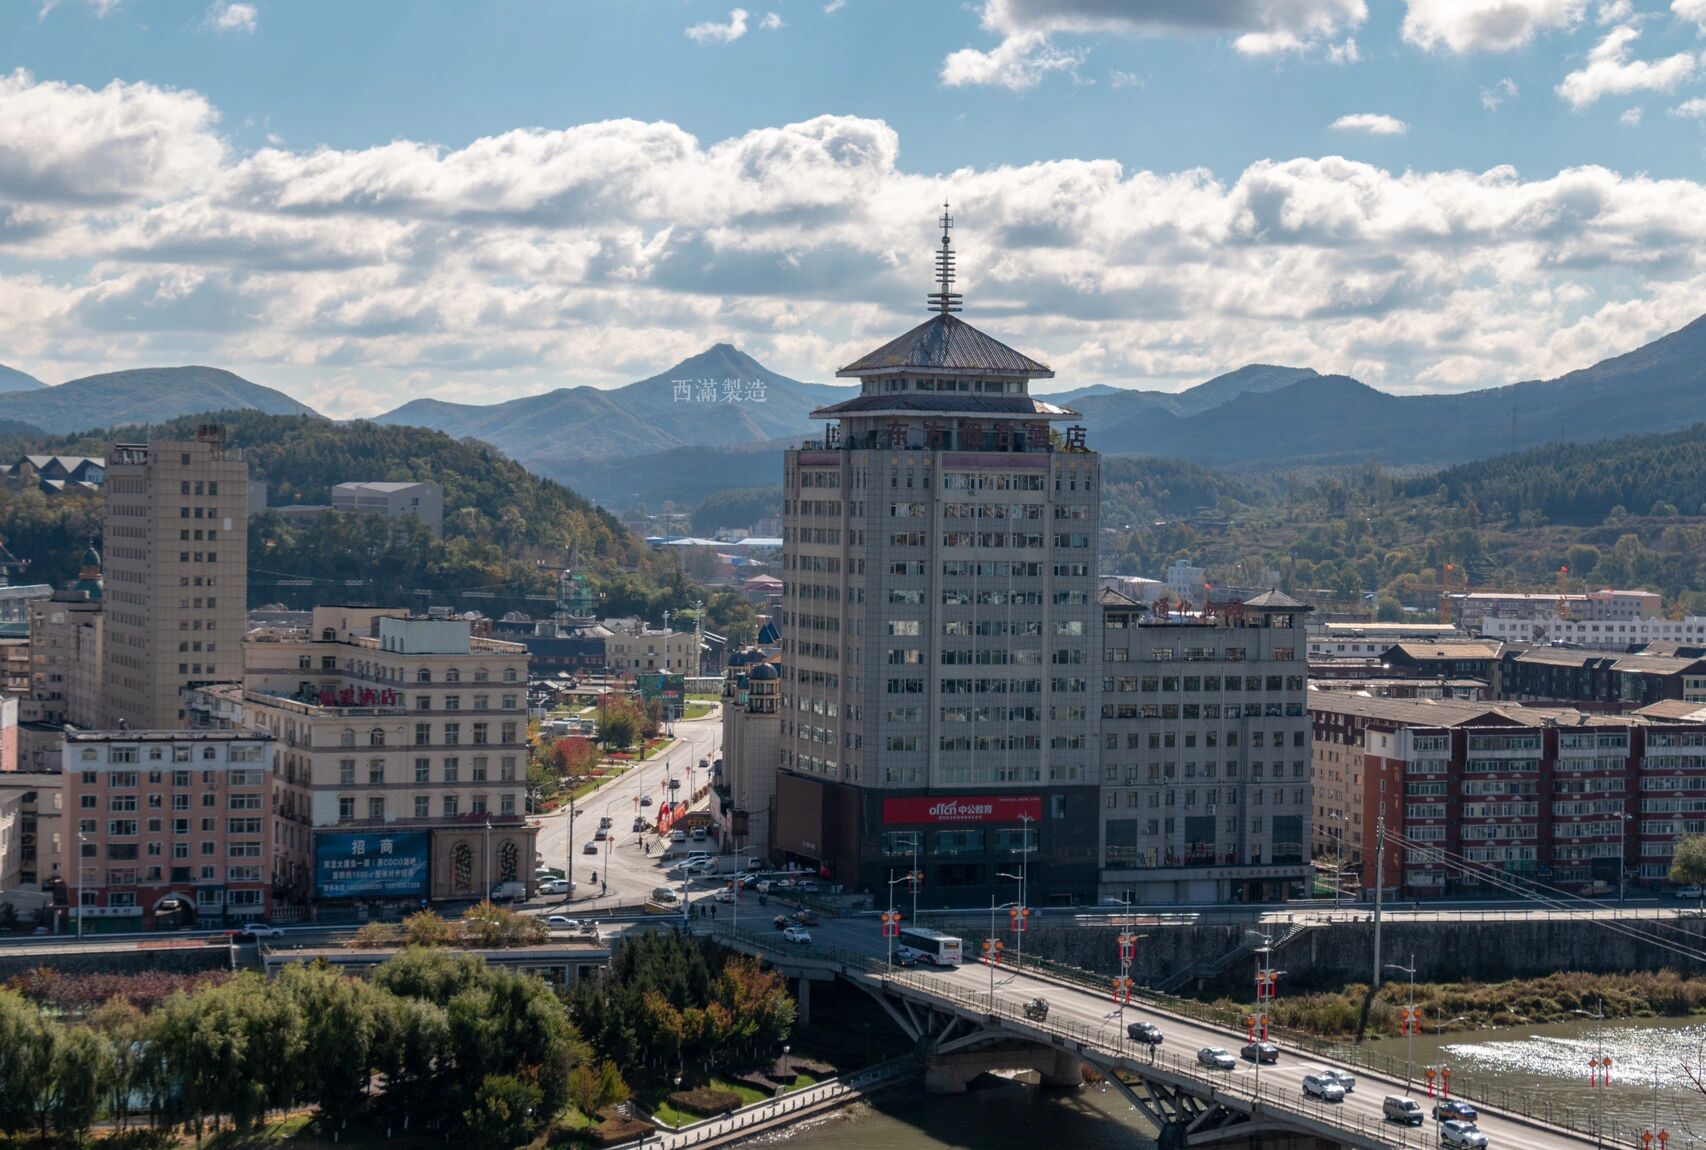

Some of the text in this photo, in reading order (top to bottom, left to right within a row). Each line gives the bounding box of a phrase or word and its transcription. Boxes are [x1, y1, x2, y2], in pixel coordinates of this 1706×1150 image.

[929, 801, 992, 815] offcn 中公教育
[352, 839, 393, 855] 招商
